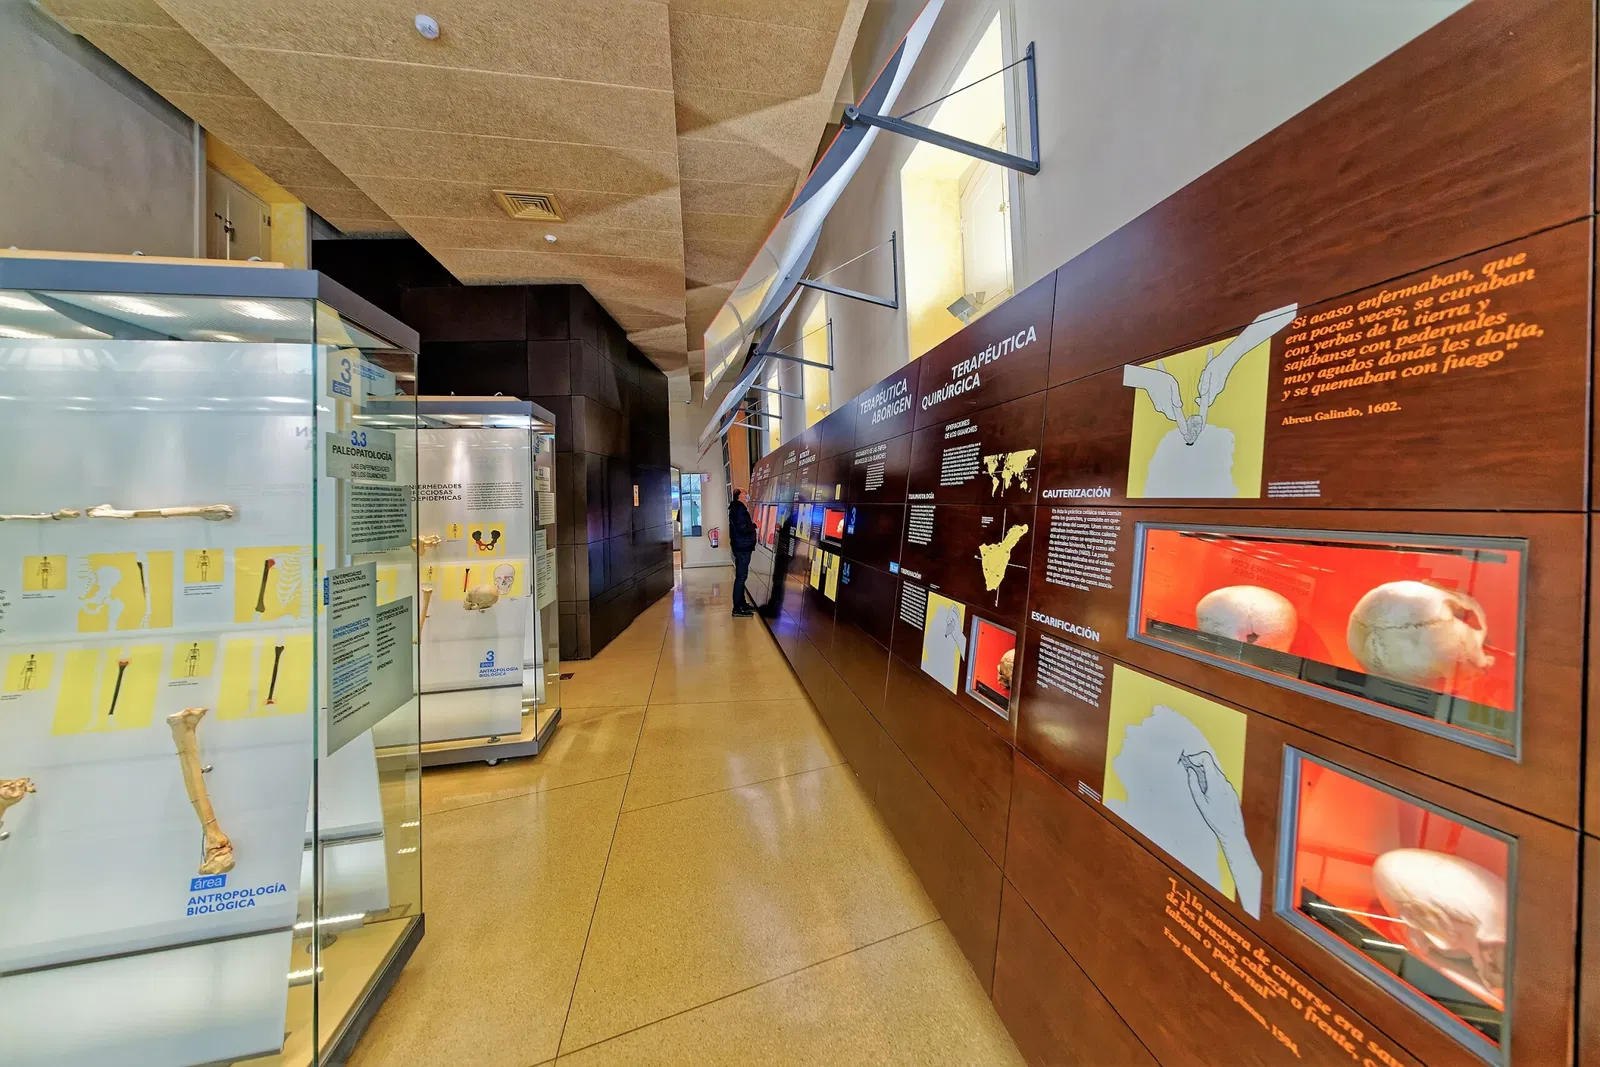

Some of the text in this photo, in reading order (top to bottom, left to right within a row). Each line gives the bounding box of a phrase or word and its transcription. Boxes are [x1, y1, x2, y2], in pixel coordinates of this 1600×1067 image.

[1285, 268, 1536, 345] era pocas veces, se curaban
[1309, 304, 1354, 325] acaso
[1356, 269, 1475, 310] enfermaban,
[1481, 252, 1527, 277] que
[1284, 298, 1491, 358] con yerbas de la tierra y
[1284, 312, 1508, 372] sajábanse con pedernales
[341, 358, 352, 383] 3
[950, 325, 1038, 381] TERAPÉUTICA
[1283, 322, 1545, 385] muy agudos donde les dolía,
[860, 377, 908, 416] TERAPÉUTICA
[921, 372, 982, 411] QUIRÚRGICA
[1281, 389, 1291, 402] y
[1293, 386, 1309, 397] se
[1310, 369, 1397, 396] quemaban
[1401, 361, 1438, 378] con
[871, 393, 912, 425] ABORIGEN
[1281, 401, 1402, 426] Abreu Galindo, 1602.
[332, 444, 393, 462] PALEOPATOLOGÍA
[351, 430, 367, 448] 3.3
[1042, 486, 1111, 498] CAUTERIZACIÓN
[1031, 611, 1100, 642] ESCARIFICACIÓN
[486, 650, 495, 662] 3
[187, 882, 287, 906] ANTROPOLOGÍA
[193, 877, 223, 890] área
[1165, 904, 1201, 942] tabona
[1202, 938, 1213, 949] o
[1164, 925, 1182, 949] Fray
[1210, 970, 1223, 986] de
[1191, 895, 1204, 912] la
[1204, 909, 1251, 951] manera
[1252, 947, 1271, 966] de
[1272, 964, 1332, 1016] curarse
[1333, 1014, 1364, 1043] era
[1166, 891, 1359, 1061] de los brazos, cabeza o frente,
